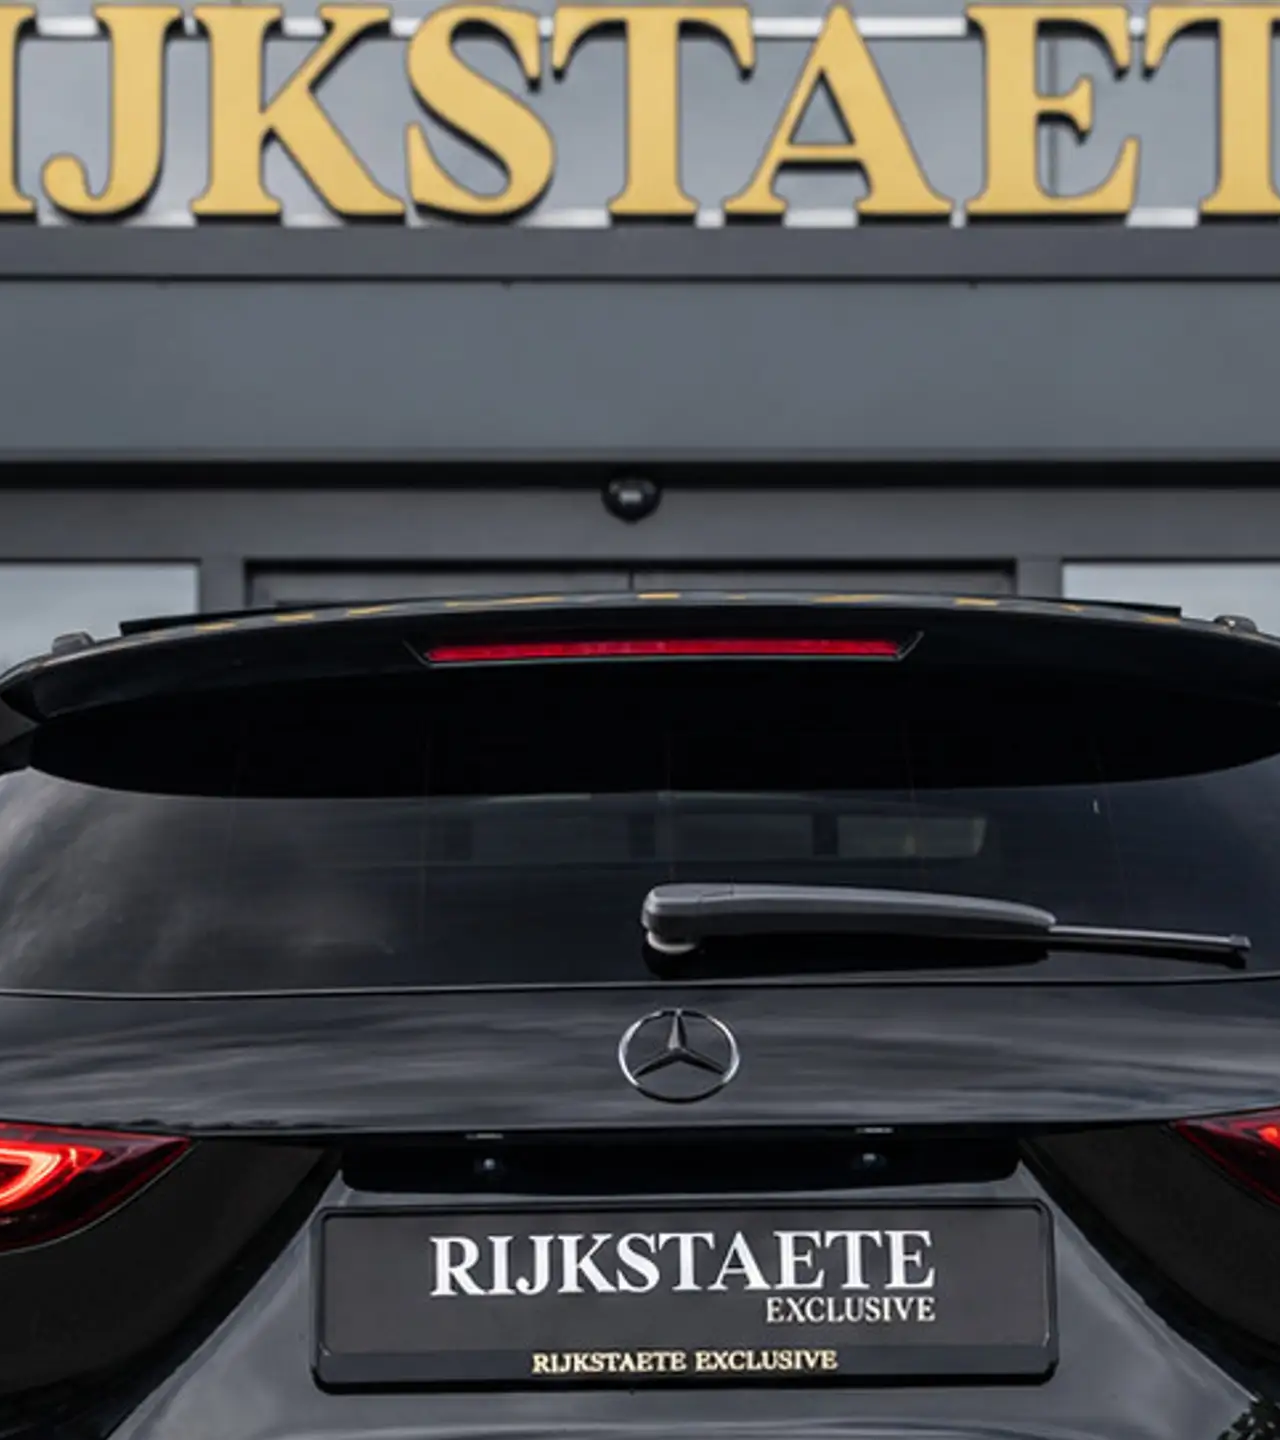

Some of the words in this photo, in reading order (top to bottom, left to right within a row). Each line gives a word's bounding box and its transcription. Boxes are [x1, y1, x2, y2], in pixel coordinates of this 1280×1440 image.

[429, 1229, 936, 1296] RIJKSTAETE
[765, 1297, 935, 1323] EXCLUSIVE
[531, 1349, 687, 1374] RIJKSTAETE
[694, 1349, 838, 1371] EXCLUSIVE
